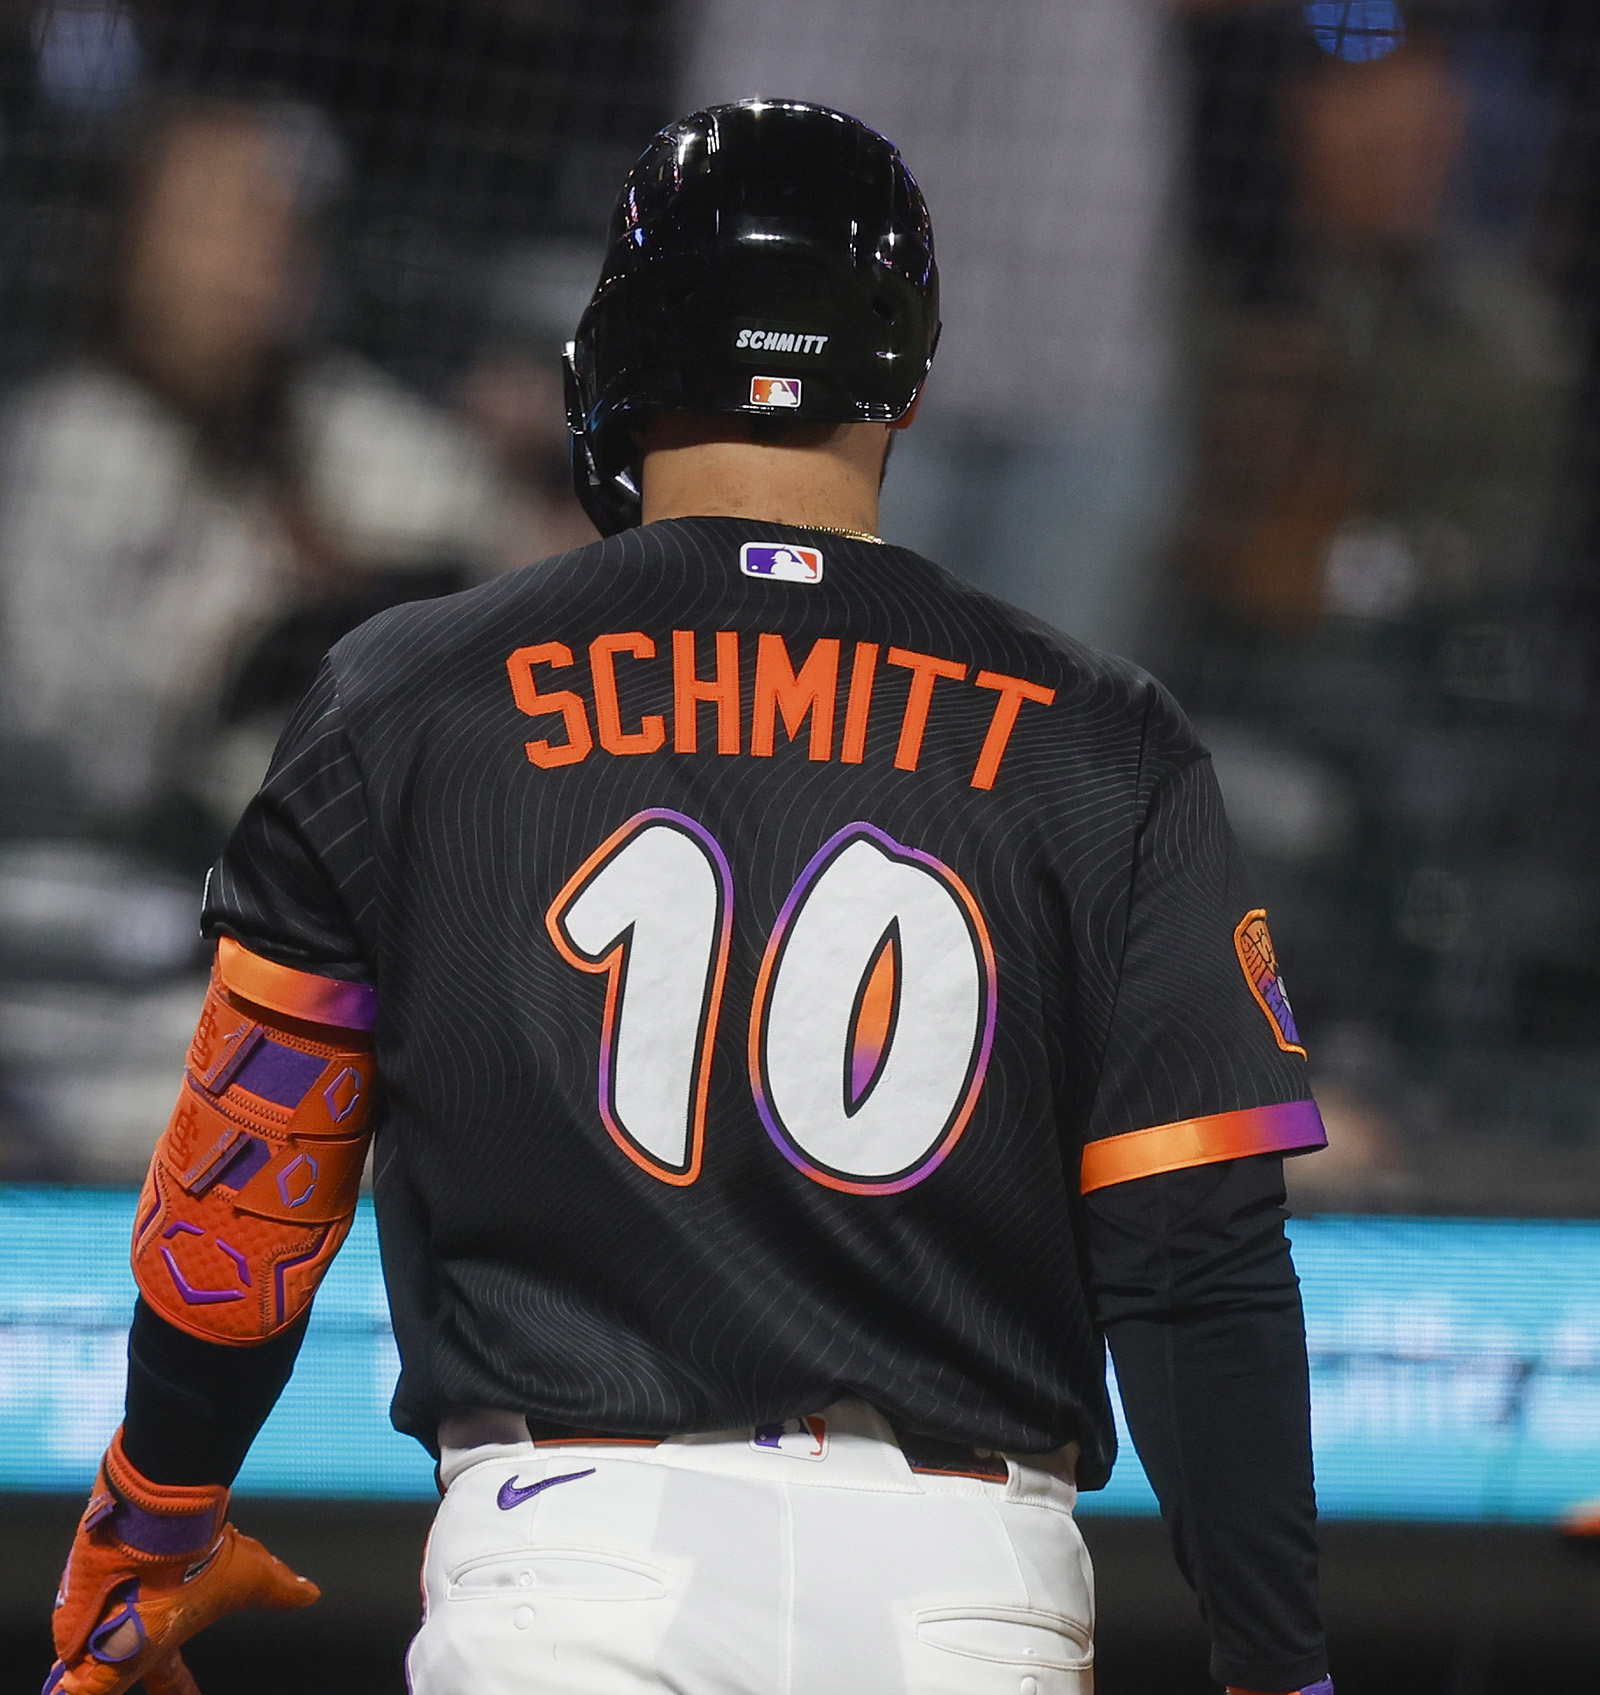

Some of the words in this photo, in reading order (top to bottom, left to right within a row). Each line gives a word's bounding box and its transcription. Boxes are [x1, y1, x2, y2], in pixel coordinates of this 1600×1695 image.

[736, 329, 829, 355] SCHMITT
[506, 629, 1056, 790] SCHMITT
[545, 807, 997, 1195] 10
